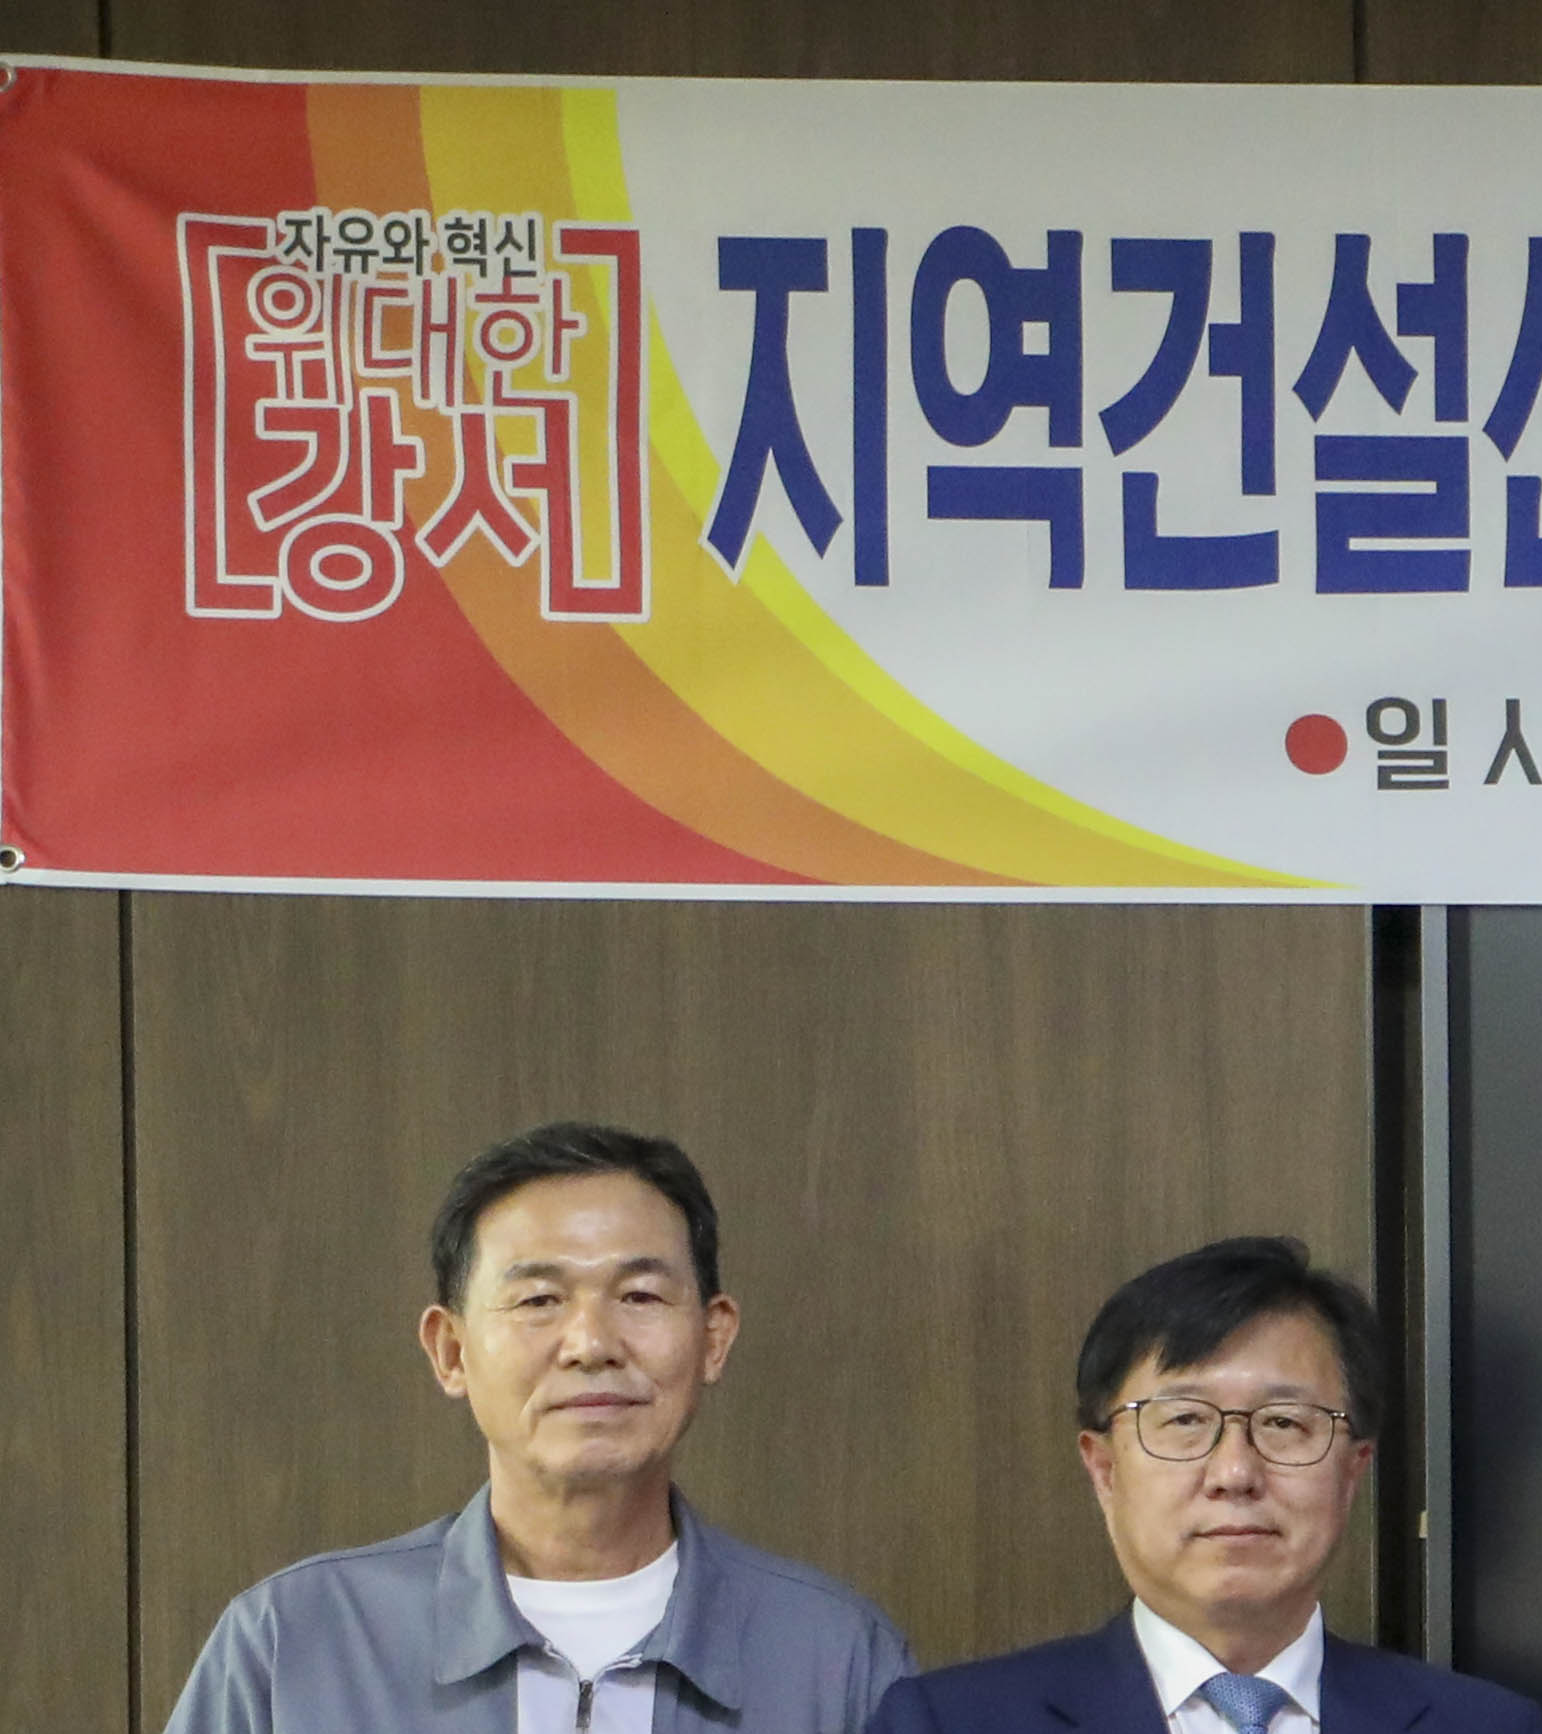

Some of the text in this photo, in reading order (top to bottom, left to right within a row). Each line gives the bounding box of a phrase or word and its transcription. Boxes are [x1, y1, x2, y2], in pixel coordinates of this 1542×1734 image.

[284, 216, 537, 277] 자유와 혁신
[248, 270, 582, 406] 위대한
[248, 394, 572, 620] 강서
